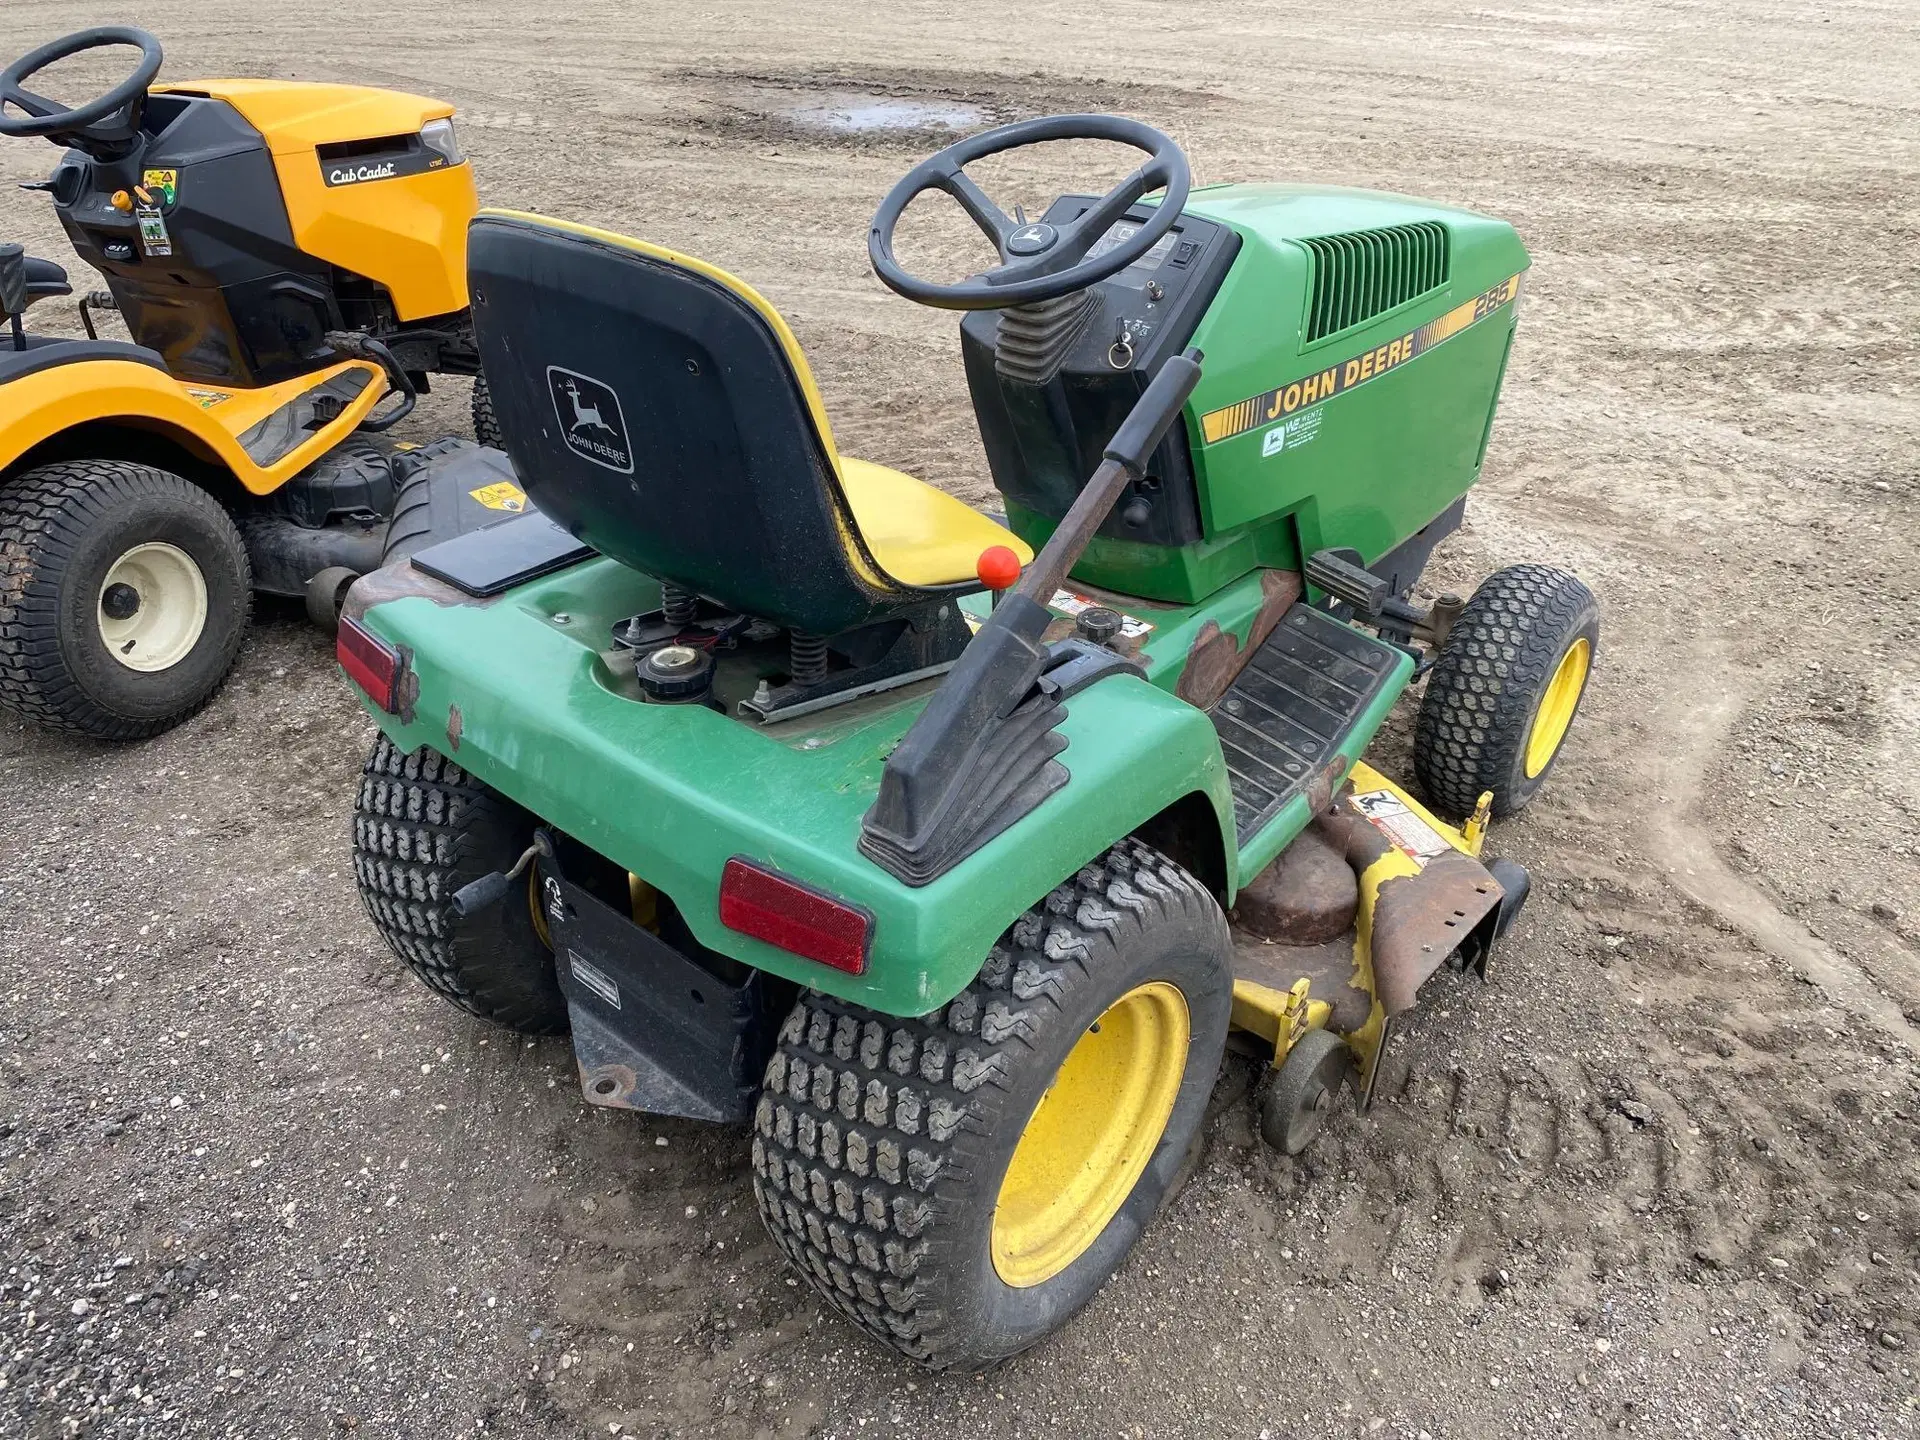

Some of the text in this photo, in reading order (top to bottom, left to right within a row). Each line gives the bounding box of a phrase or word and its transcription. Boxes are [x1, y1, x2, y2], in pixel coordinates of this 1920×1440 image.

[330, 162, 395, 184] Cub Cadet
[1474, 281, 1510, 320] 285
[1267, 333, 1415, 419] JOHN DEERE
[567, 432, 627, 465] JOHN DEERE
